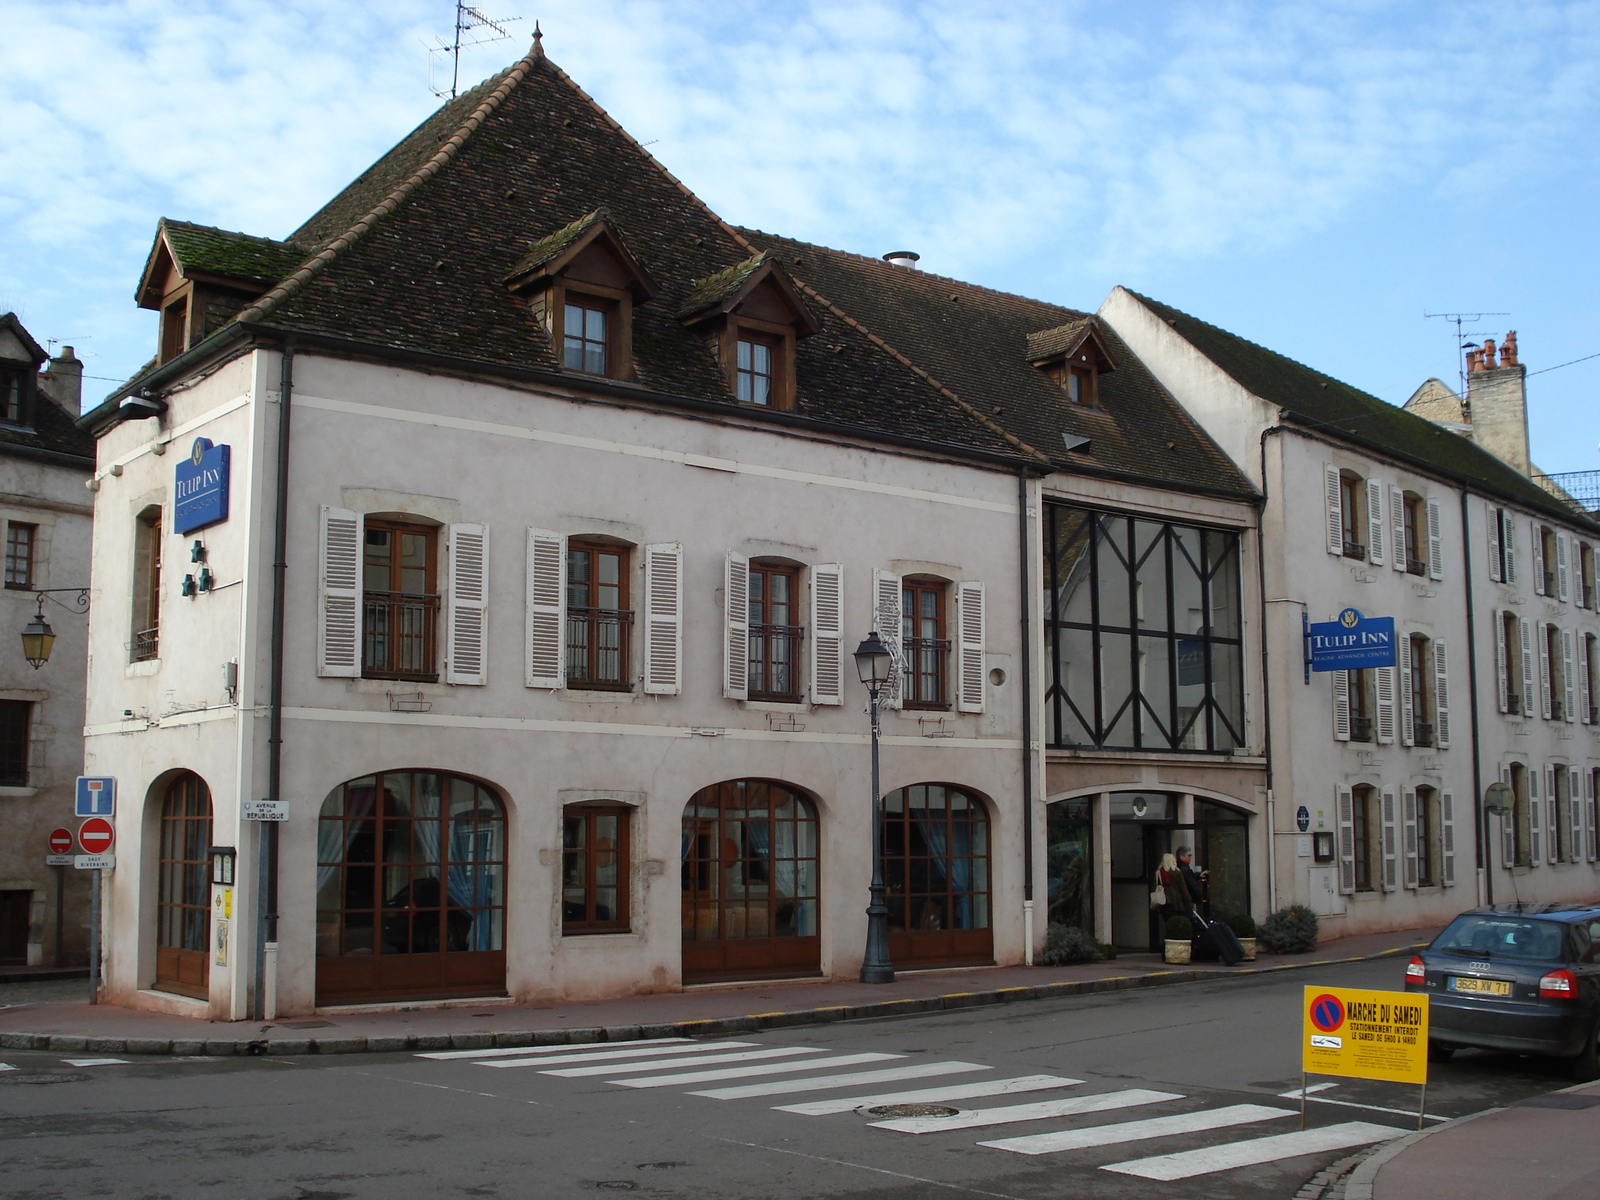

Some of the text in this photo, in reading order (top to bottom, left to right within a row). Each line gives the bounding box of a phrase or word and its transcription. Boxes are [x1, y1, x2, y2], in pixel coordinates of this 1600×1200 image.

[177, 467, 220, 498] TULIP INN
[1313, 632, 1389, 648] TULIP INN
[1456, 978, 1507, 994] 3629 XW 71
[1380, 1004, 1391, 1023] DU
[1394, 1005, 1422, 1026] SAMEDI
[1350, 1023, 1419, 1036] STATIONNEMENT INTERDIT
[1352, 1032, 1357, 1040] LE
[1358, 1033, 1375, 1042] SAMEDI
[1376, 1034, 1383, 1042] DE
